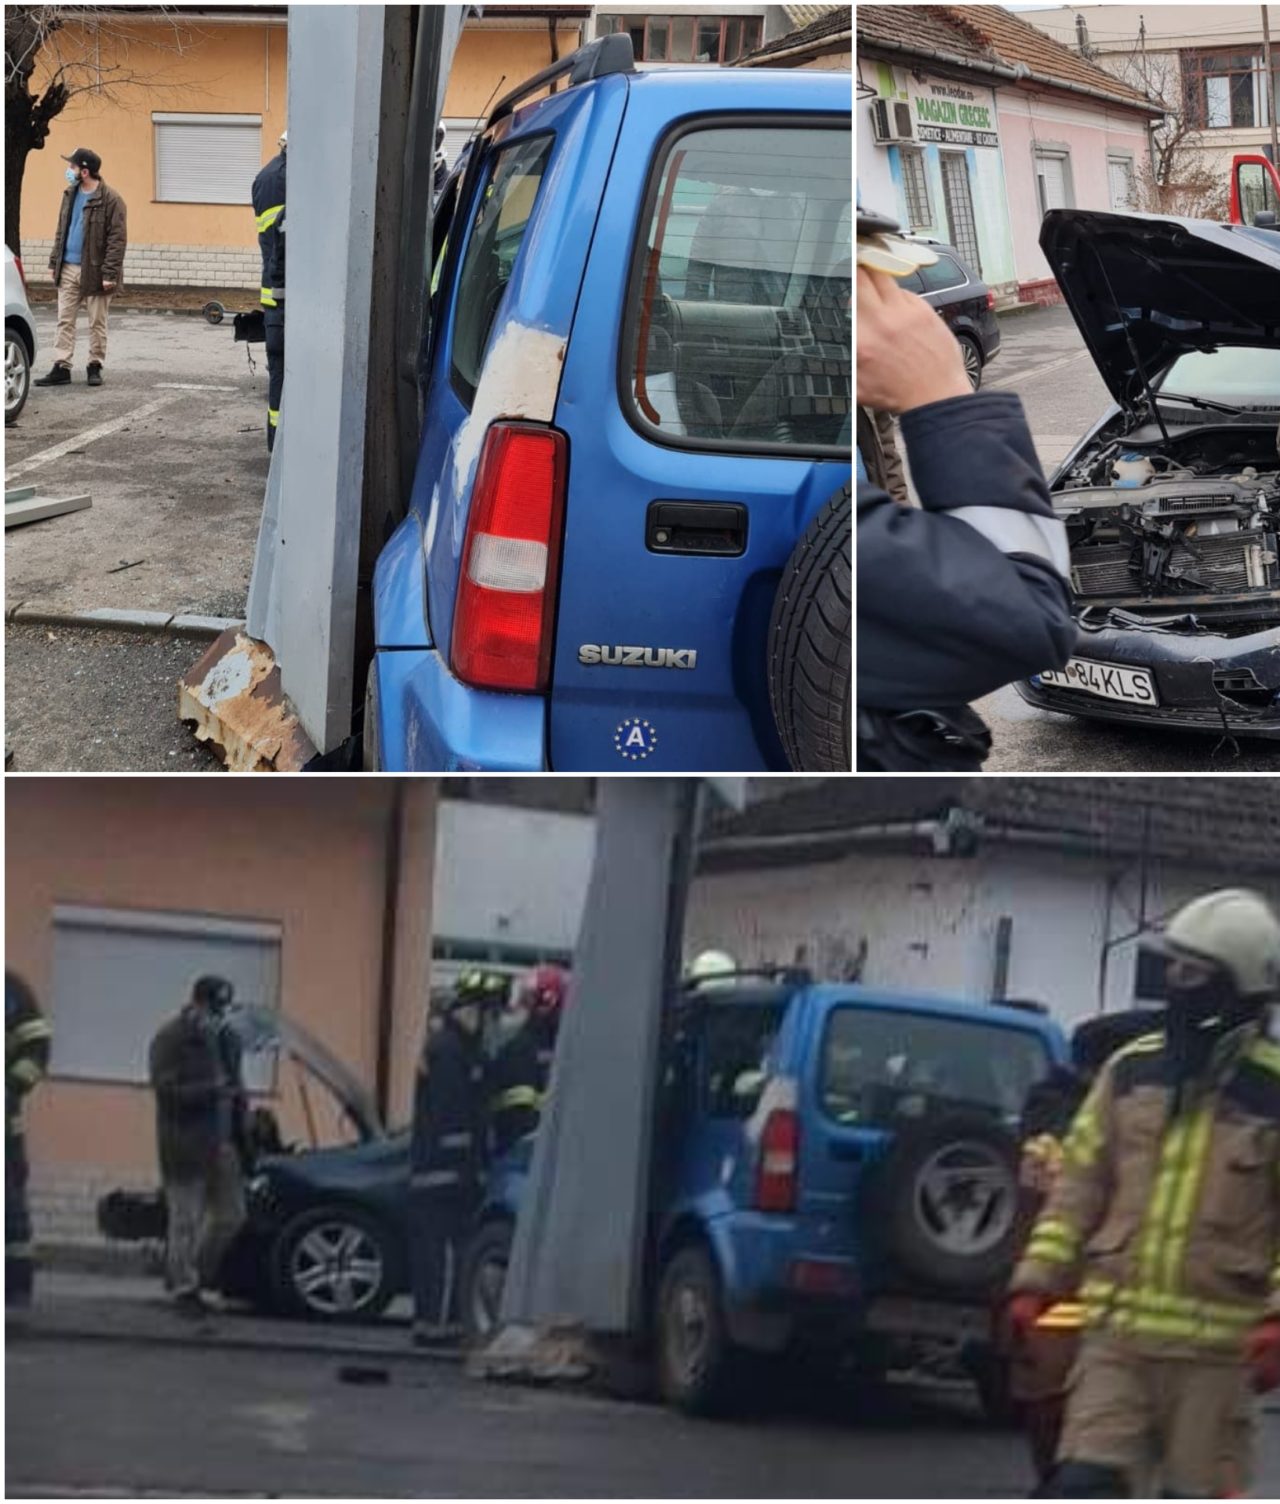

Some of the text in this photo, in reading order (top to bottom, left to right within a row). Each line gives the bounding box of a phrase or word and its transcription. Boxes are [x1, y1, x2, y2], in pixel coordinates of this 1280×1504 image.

[915, 97, 991, 129] MAGAZIN GRECESC
[579, 644, 697, 669] SUZUKI
[1075, 662, 1152, 700] 84KLS
[625, 726, 645, 747] A
